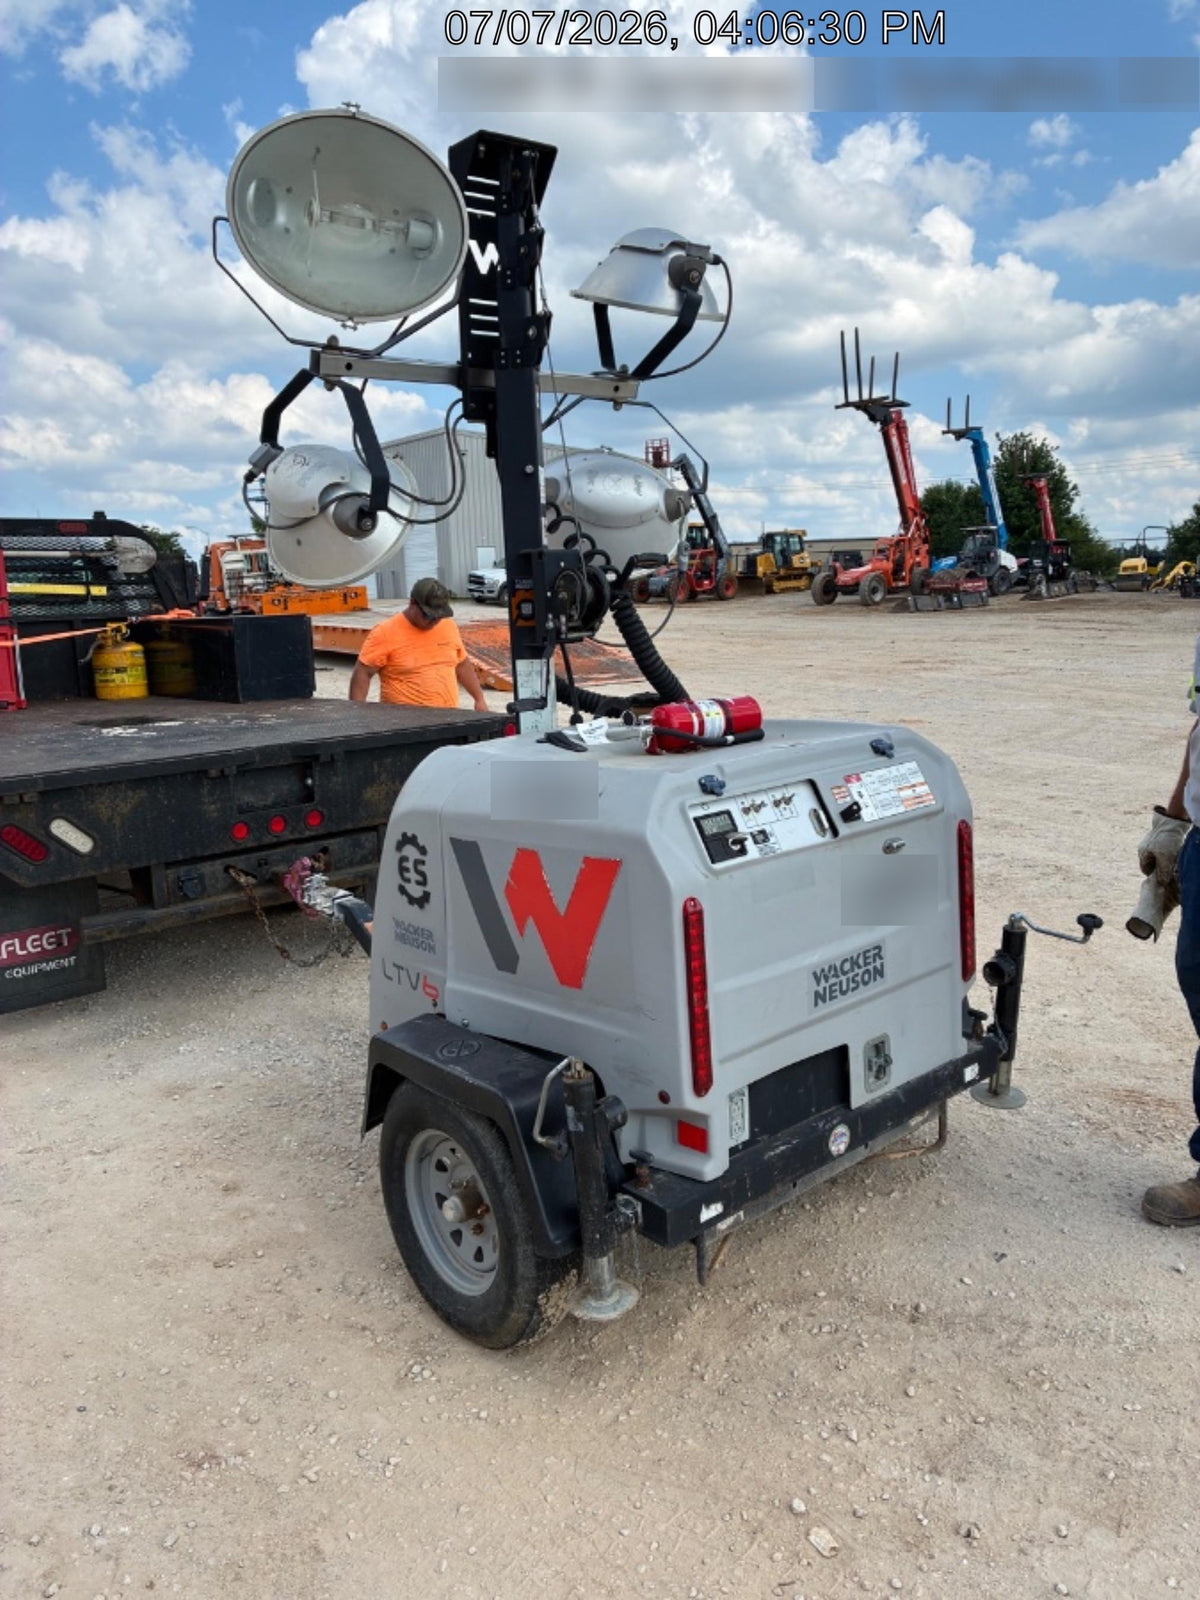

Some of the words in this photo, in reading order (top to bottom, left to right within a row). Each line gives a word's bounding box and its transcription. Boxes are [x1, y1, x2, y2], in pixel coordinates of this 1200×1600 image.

[393, 917, 434, 943] WACKER
[382, 957, 440, 1000] LTV6
[812, 945, 884, 987] WACKER
[814, 961, 884, 1008] NEUSON
